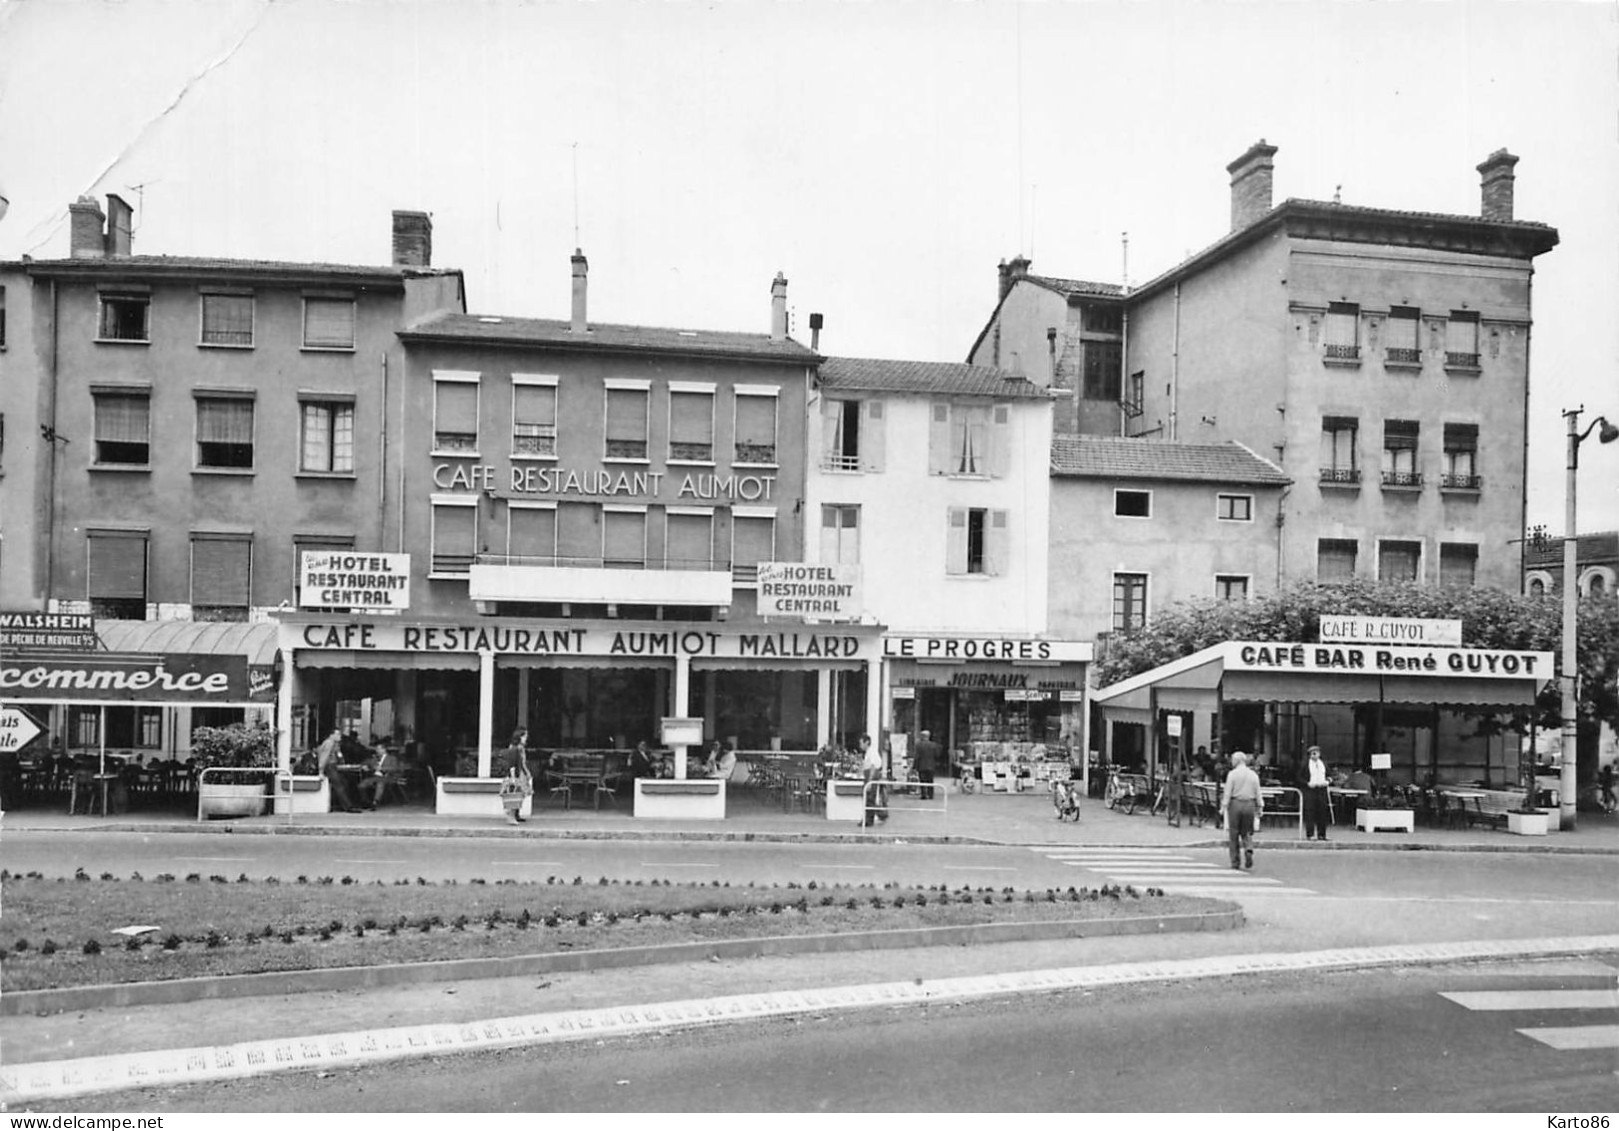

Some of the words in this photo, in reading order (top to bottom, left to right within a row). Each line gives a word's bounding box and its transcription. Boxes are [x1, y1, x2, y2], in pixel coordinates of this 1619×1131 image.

[433, 463, 495, 490] CAFE
[511, 466, 663, 497] RESTAURANT
[678, 473, 777, 500] AUMIOT
[329, 556, 392, 572] HOTEL
[307, 573, 407, 589] RESTAURANT
[784, 567, 835, 580] HOTEL
[321, 590, 392, 605] CENTRAL
[763, 583, 853, 597] RESTAURANT
[776, 599, 841, 612] CENTRAL
[0, 614, 92, 629] WALSHEIM
[1380, 623, 1424, 640] GUYOT
[35, 635, 46, 645] DE
[304, 624, 376, 648] CAFE
[404, 627, 587, 653] RESTAURANT
[610, 631, 722, 655] AUMIOT
[739, 633, 860, 657] MALLARD
[884, 639, 914, 656] LE
[927, 640, 1051, 659] PROGRES
[1241, 645, 1305, 667] CAFÉ
[1315, 648, 1364, 669] BAR
[1376, 650, 1437, 671] René
[1448, 653, 1538, 675] GUYOT
[947, 672, 1029, 688] JOURNAUX
